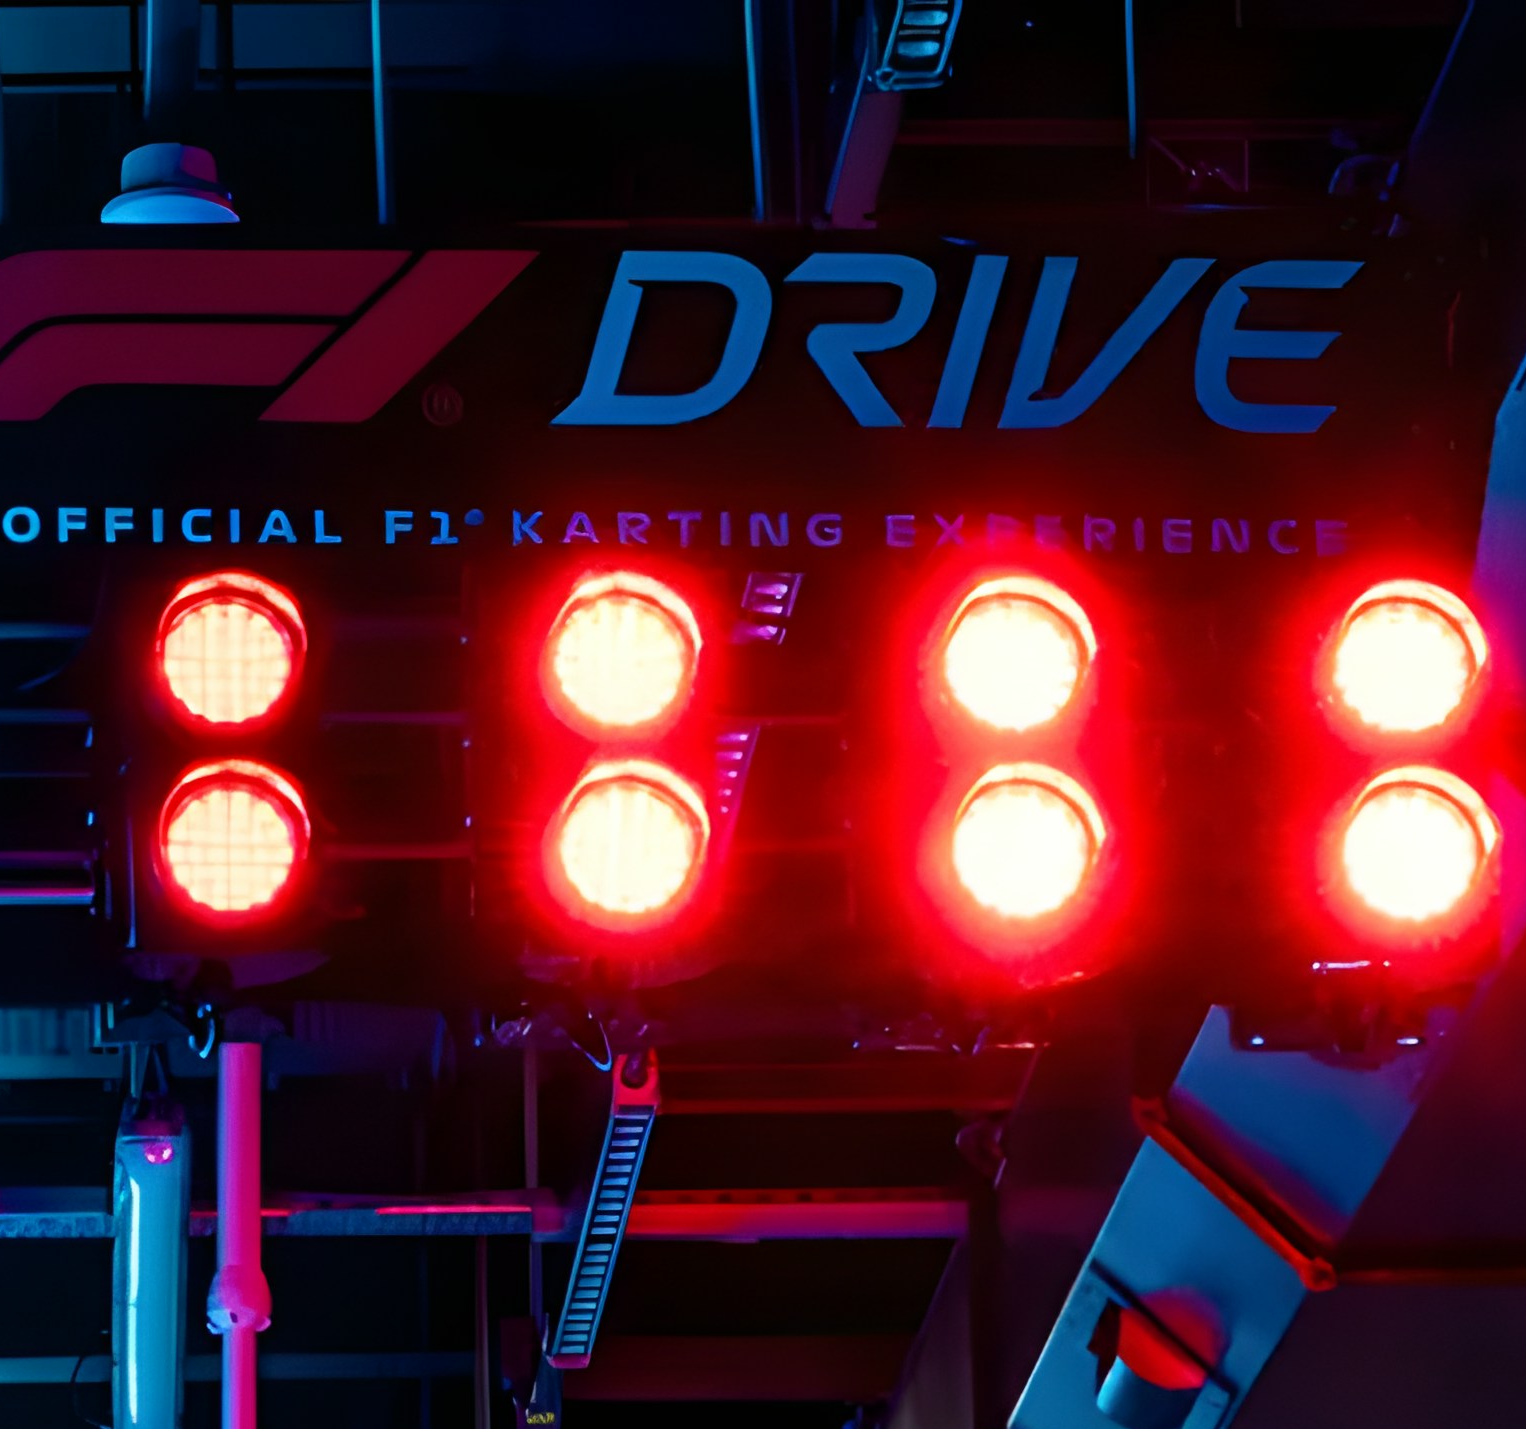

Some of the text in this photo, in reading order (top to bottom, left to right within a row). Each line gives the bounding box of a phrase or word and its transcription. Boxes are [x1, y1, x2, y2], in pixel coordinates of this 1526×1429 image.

[550, 249, 1366, 433] DRIVE
[1, 505, 343, 545] OFFICIAL
[511, 509, 844, 549] KARTING
[883, 511, 1349, 559] EXPERIENCE
